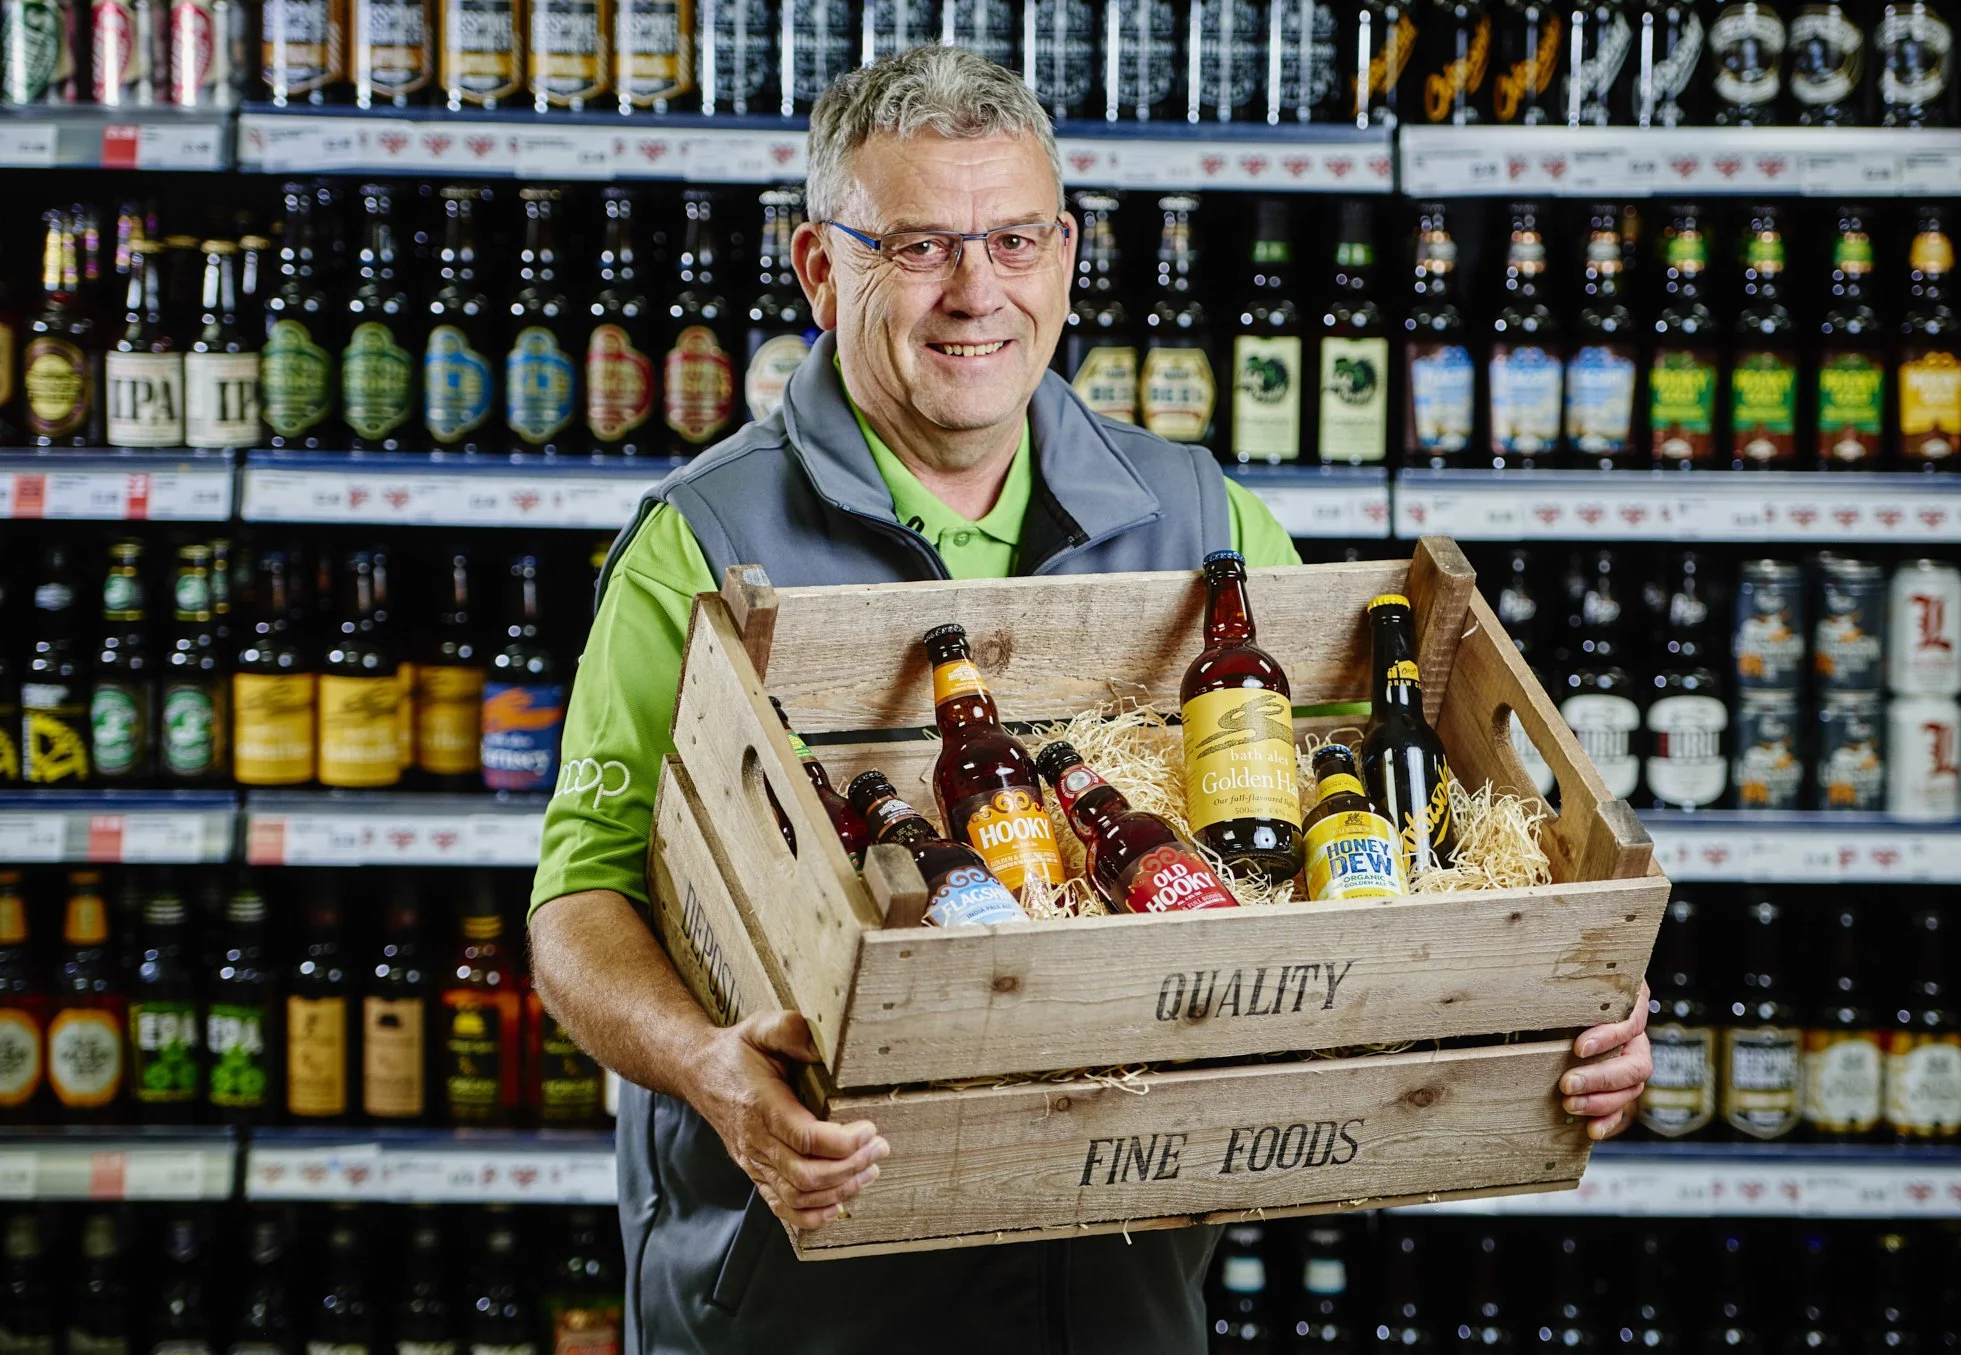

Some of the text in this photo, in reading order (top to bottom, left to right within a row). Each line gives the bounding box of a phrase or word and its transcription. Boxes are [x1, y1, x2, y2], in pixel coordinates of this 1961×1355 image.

[111, 379, 176, 421] IPA
[216, 379, 262, 421] IP
[1230, 747, 1289, 766] bath ales
[1202, 766, 1275, 795] Golden
[1213, 797, 1229, 806] Our
[1229, 793, 1283, 805] full-flavoured
[978, 816, 1051, 850] HOOKY
[1326, 838, 1389, 860] HONEY
[1153, 863, 1188, 888] OLD
[1329, 852, 1392, 880] DEW
[1343, 874, 1385, 883] ORGANIC
[1145, 871, 1216, 913] HOOKY
[1344, 880, 1374, 889] GOLDEN
[966, 906, 985, 919] INDIA
[1188, 898, 1202, 909] FULL
[1155, 960, 1357, 1022] QUALITY
[1078, 1118, 1365, 1187] FINE FOODS
